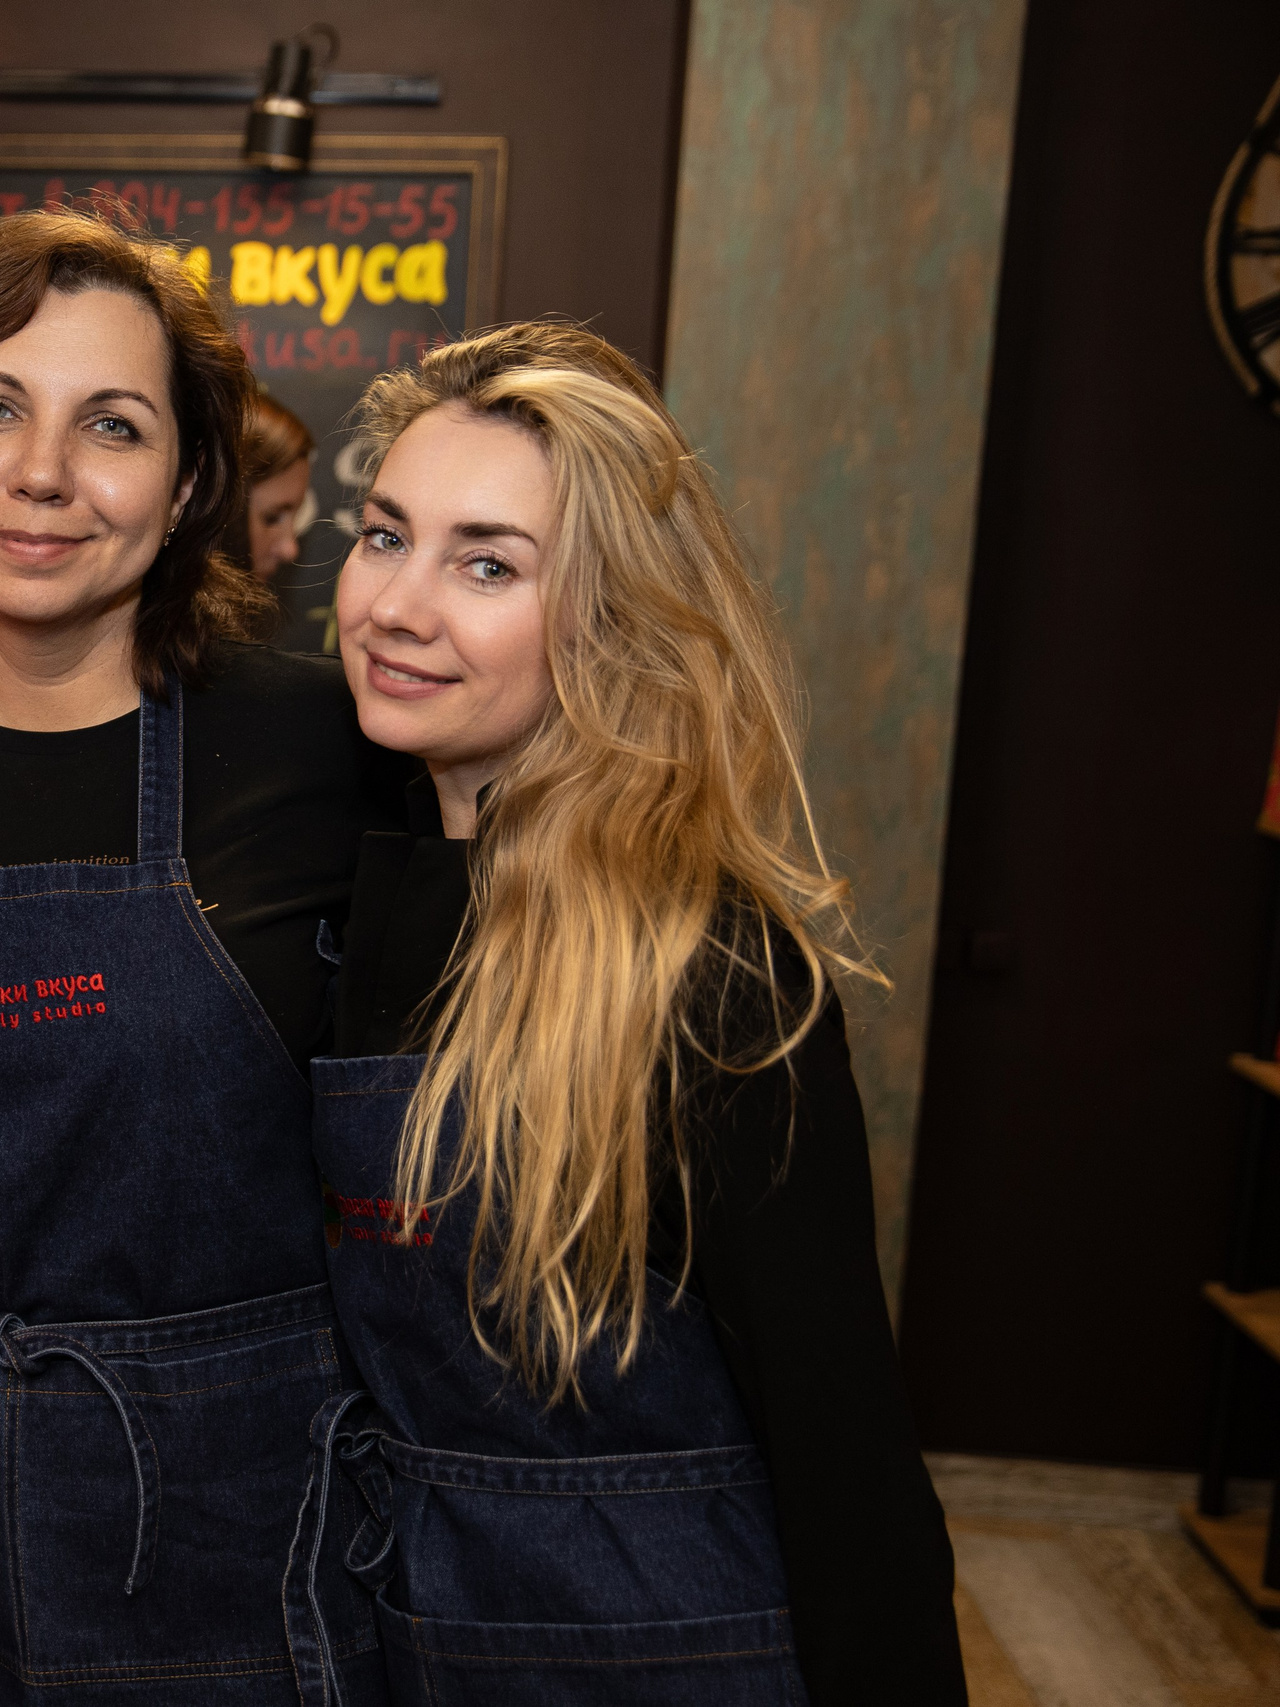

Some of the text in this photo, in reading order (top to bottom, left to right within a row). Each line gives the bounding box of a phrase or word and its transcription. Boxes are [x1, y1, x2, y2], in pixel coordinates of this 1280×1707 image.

[230, 240, 448, 327] вкуса
[34, 972, 105, 1001] вкуса
[32, 1001, 106, 1023] studio
